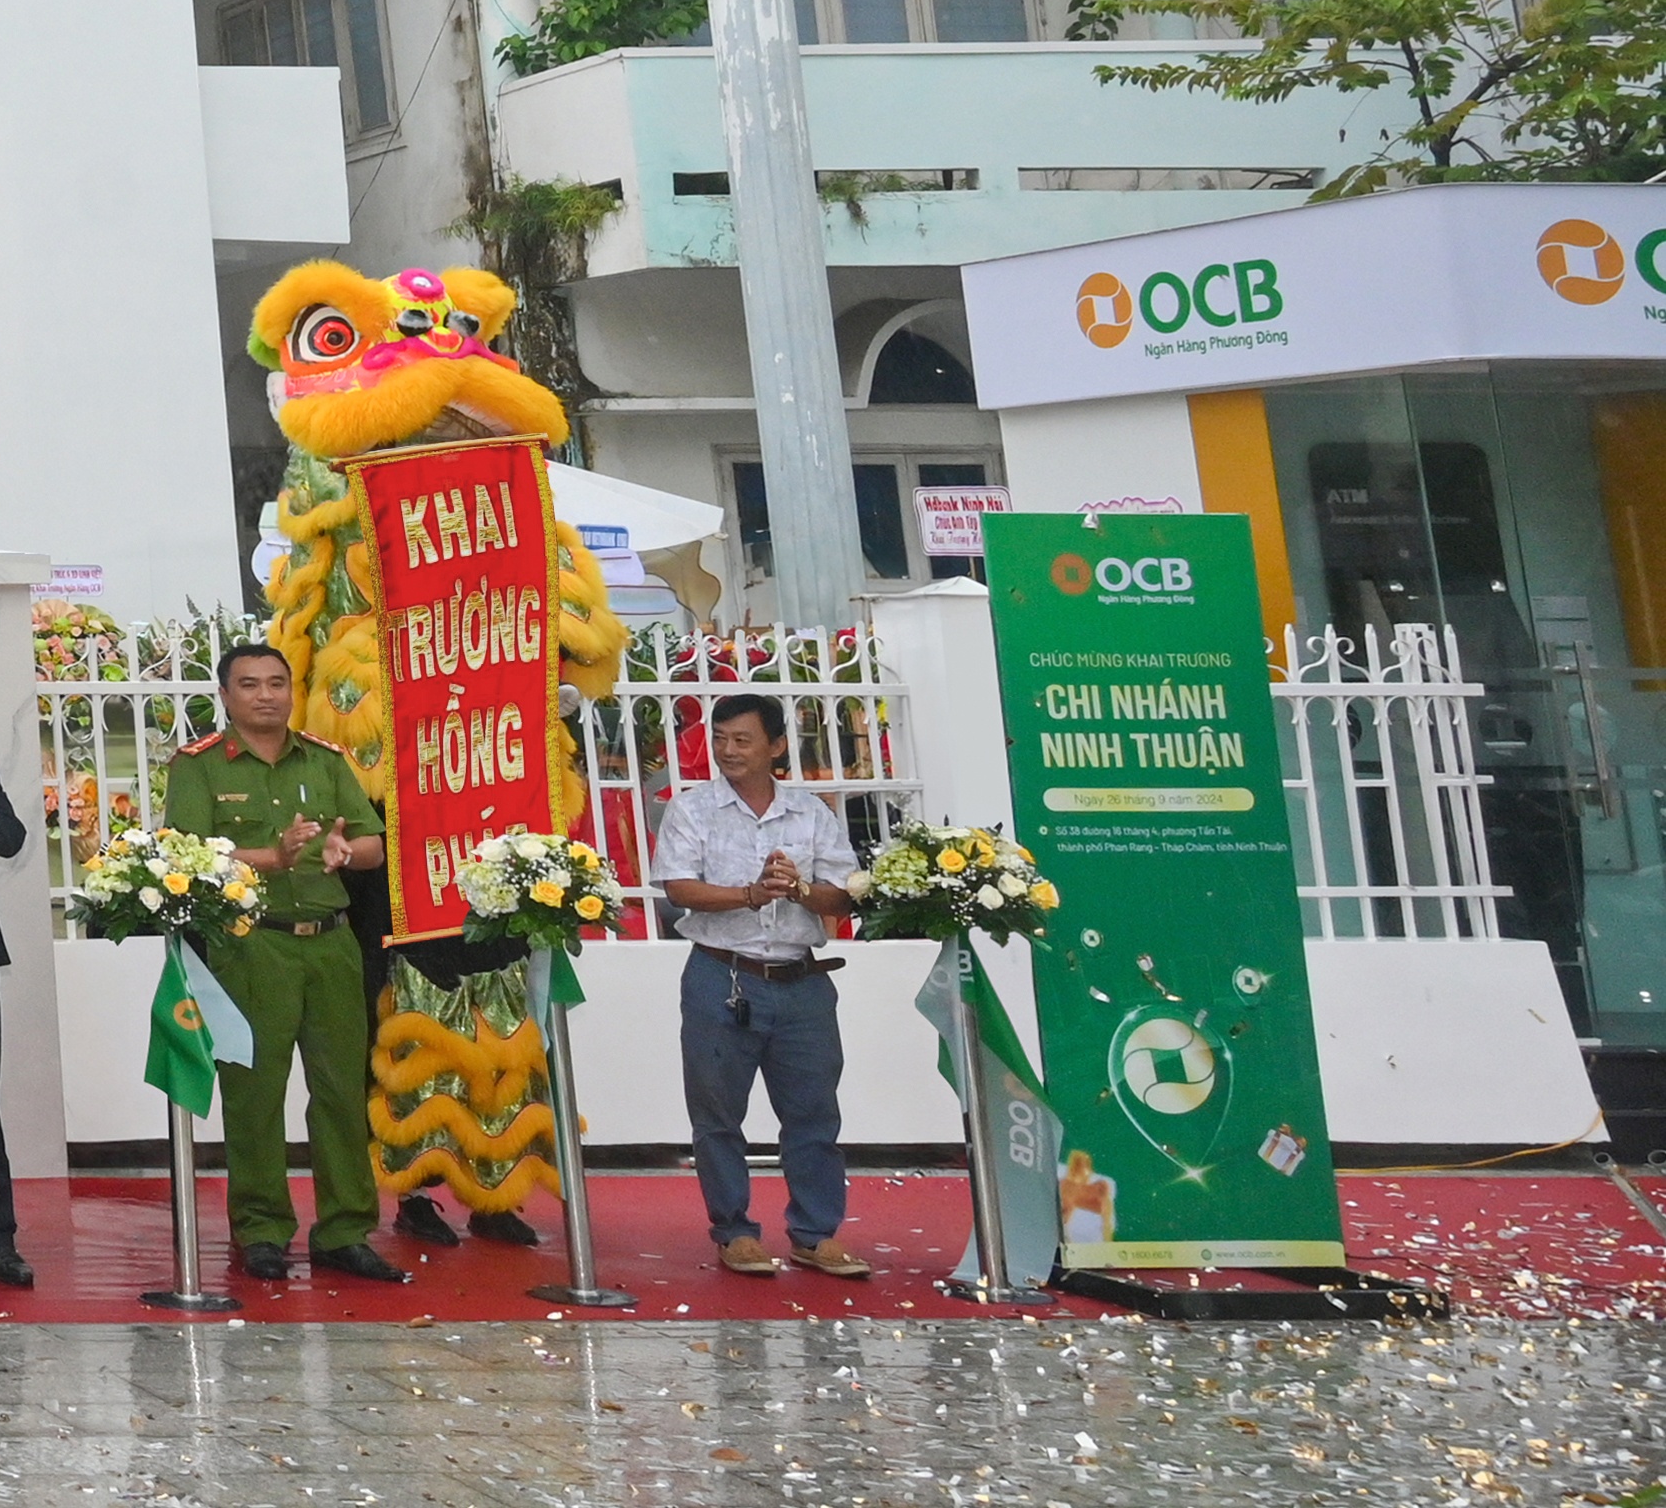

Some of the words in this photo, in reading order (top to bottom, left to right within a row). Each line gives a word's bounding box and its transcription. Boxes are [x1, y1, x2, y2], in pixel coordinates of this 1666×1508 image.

[1139, 259, 1283, 333] OCB
[1145, 343, 1173, 359] Ngân
[1177, 340, 1206, 354] Hàng
[1209, 335, 1253, 349] Phương
[1256, 330, 1288, 346] Đông
[1327, 488, 1368, 504] ATM
[399, 481, 519, 570] KHAI
[1095, 557, 1192, 591] OCB
[387, 576, 541, 683] TRƯƠNG
[1029, 652, 1073, 668] CHÚC
[1077, 652, 1123, 668] MỪNG
[1127, 653, 1164, 668] KHAI
[1168, 652, 1231, 668] TRƯƠNG
[1046, 683, 1102, 720] CHI
[1111, 678, 1227, 720] NHÁNH
[416, 684, 525, 794] HỒNG
[1040, 733, 1123, 768] NINH
[1130, 725, 1245, 775] THUẬN
[1107, 794, 1121, 805] 26
[1158, 794, 1165, 805] 9
[1196, 794, 1223, 805] 2024
